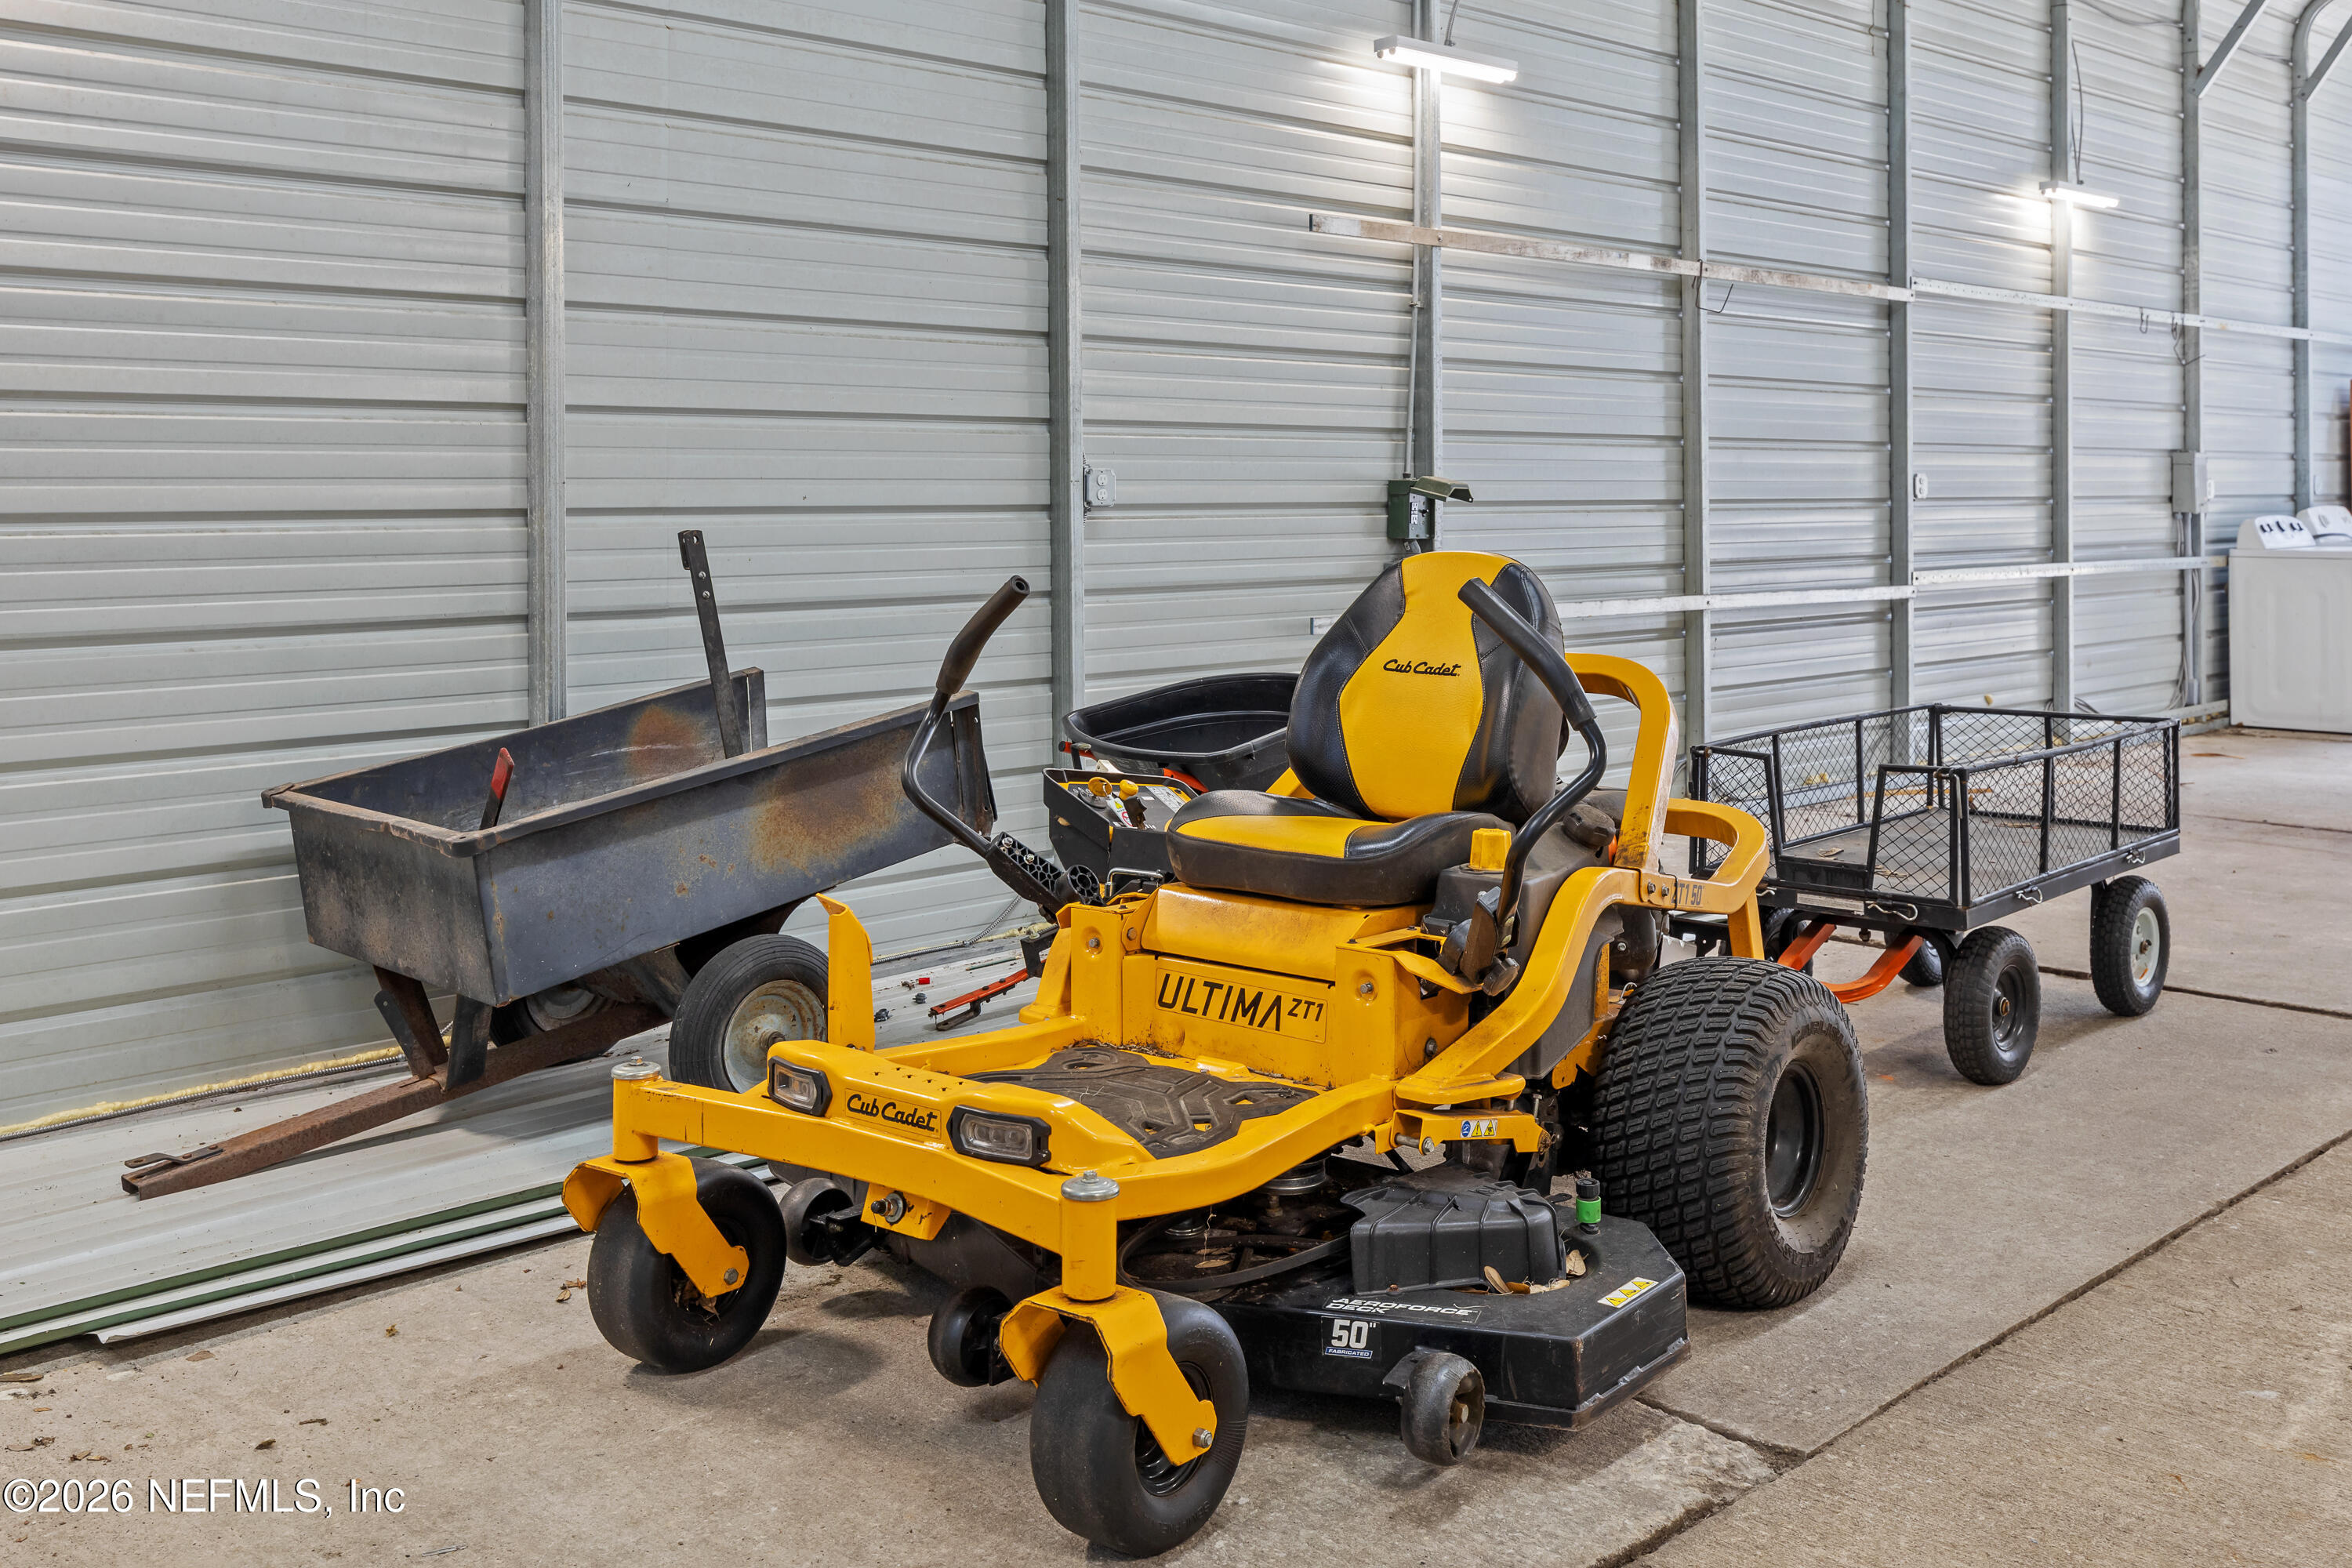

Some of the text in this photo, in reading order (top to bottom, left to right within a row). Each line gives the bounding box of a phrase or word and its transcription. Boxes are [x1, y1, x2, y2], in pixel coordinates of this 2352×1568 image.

[1383, 659, 1461, 677] Cub Cadet
[1157, 973, 1324, 1033] ULTIMA ZT1
[847, 1094, 938, 1132] Cub Cadet
[1325, 1303, 1391, 1314] DECK
[1330, 1319, 1377, 1349] 50"
